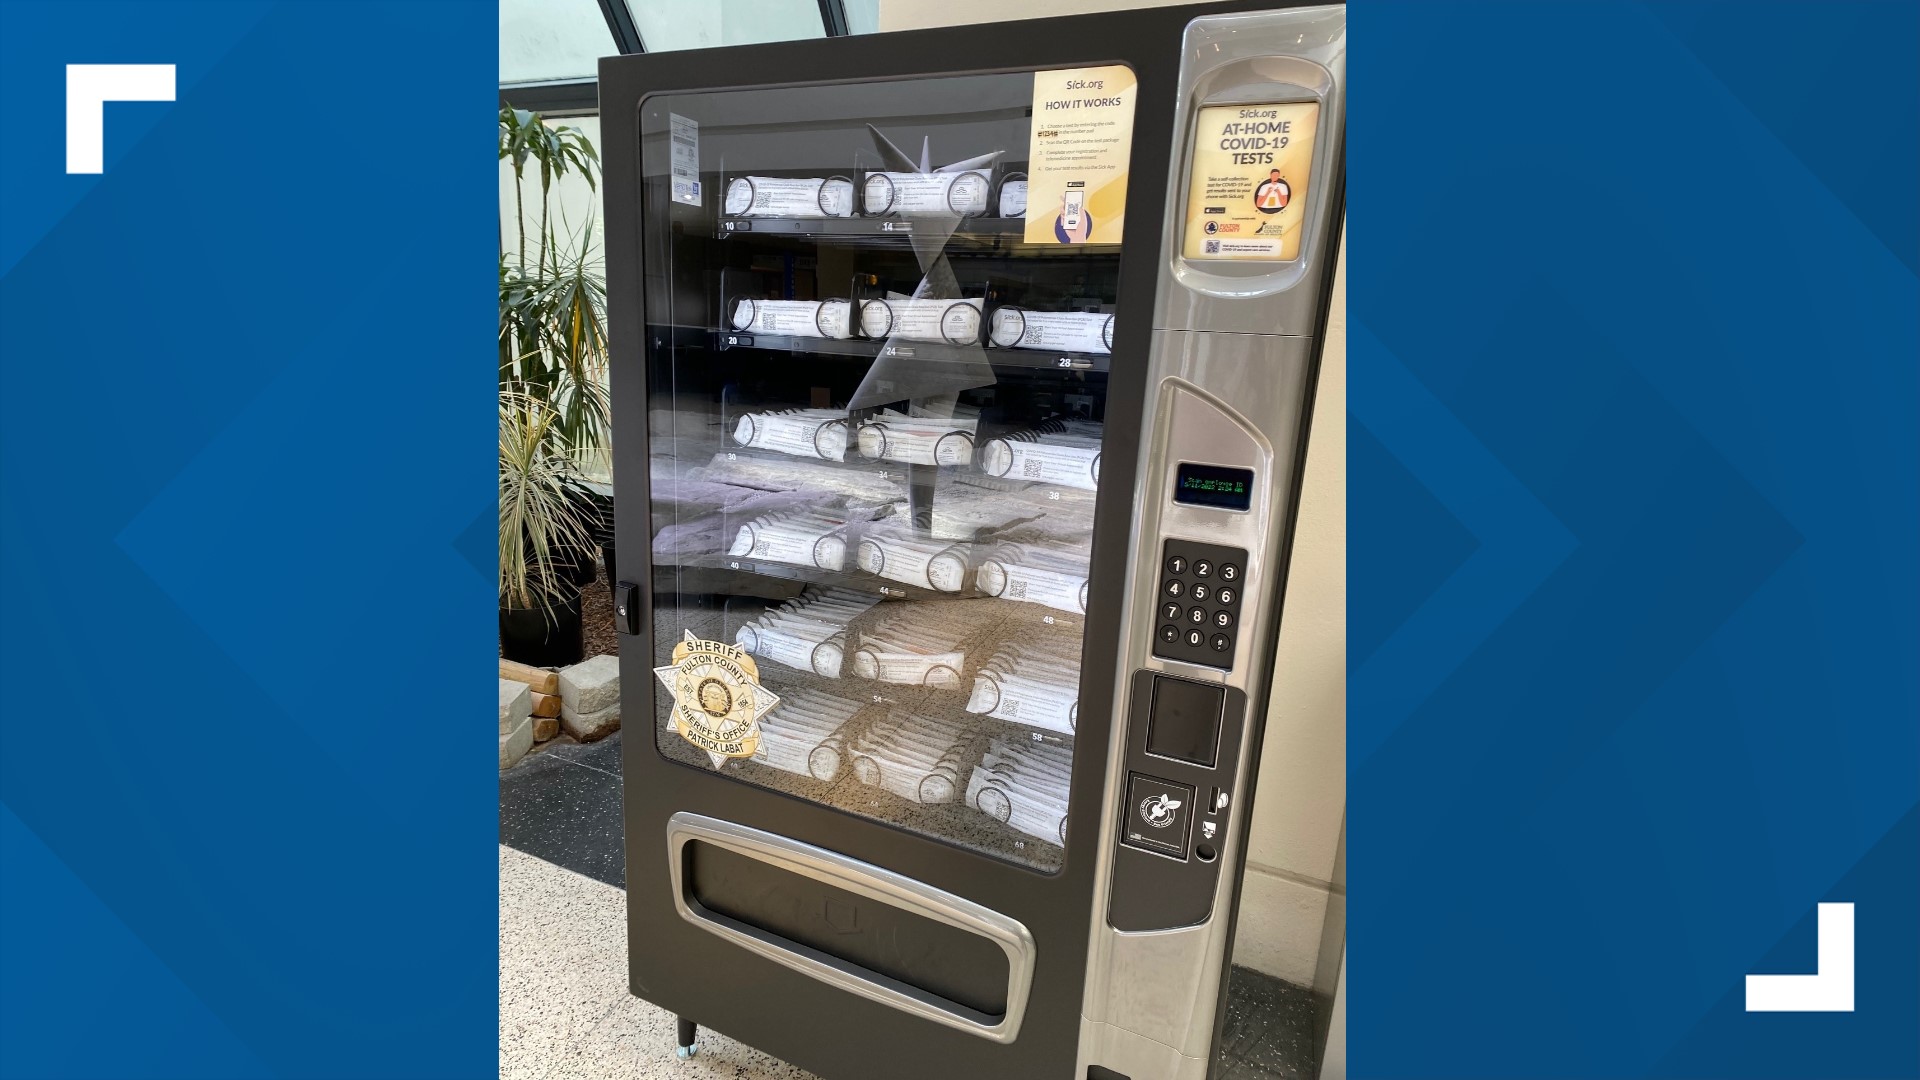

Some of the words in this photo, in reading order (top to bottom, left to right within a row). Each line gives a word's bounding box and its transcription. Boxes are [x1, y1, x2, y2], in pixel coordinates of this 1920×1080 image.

[1066, 80, 1104, 90] Sick.org
[1045, 100, 1071, 110] HOW
[1072, 99, 1082, 109] IT
[1084, 97, 1122, 108] WORKS
[1239, 109, 1278, 119] Sick.org
[1222, 121, 1291, 135] AT-HOME
[1220, 136, 1289, 150] COVID-19
[1232, 152, 1274, 164] TESTS
[725, 221, 735, 231] 10
[883, 222, 893, 231] 14
[728, 337, 738, 345] 20
[886, 347, 896, 356] 24
[1059, 358, 1071, 367] 28
[727, 452, 737, 461] 30
[879, 470, 888, 479] 34
[1048, 491, 1060, 500] 38
[730, 561, 739, 570] 40
[1173, 560, 1181, 572] 1
[1198, 563, 1208, 575] 2
[1224, 566, 1234, 579] 3
[880, 586, 889, 595] 44
[1170, 583, 1178, 595] 4
[1196, 586, 1205, 598] 5
[1221, 590, 1231, 603] 6
[1043, 615, 1054, 624] 48
[1168, 606, 1176, 618] 7
[1193, 610, 1202, 622] 8
[1218, 614, 1228, 626] 9
[1190, 632, 1199, 644] 0
[686, 641, 743, 660] SHERIFF
[681, 654, 712, 675] FULTON
[714, 656, 748, 685] COUNTY
[683, 684, 694, 695] EST
[681, 704, 721, 740] SHERIFF'S
[722, 719, 750, 740] OFFICE
[687, 729, 719, 751] PATRICK
[720, 742, 744, 754] LABAT
[1032, 732, 1043, 742] 58
